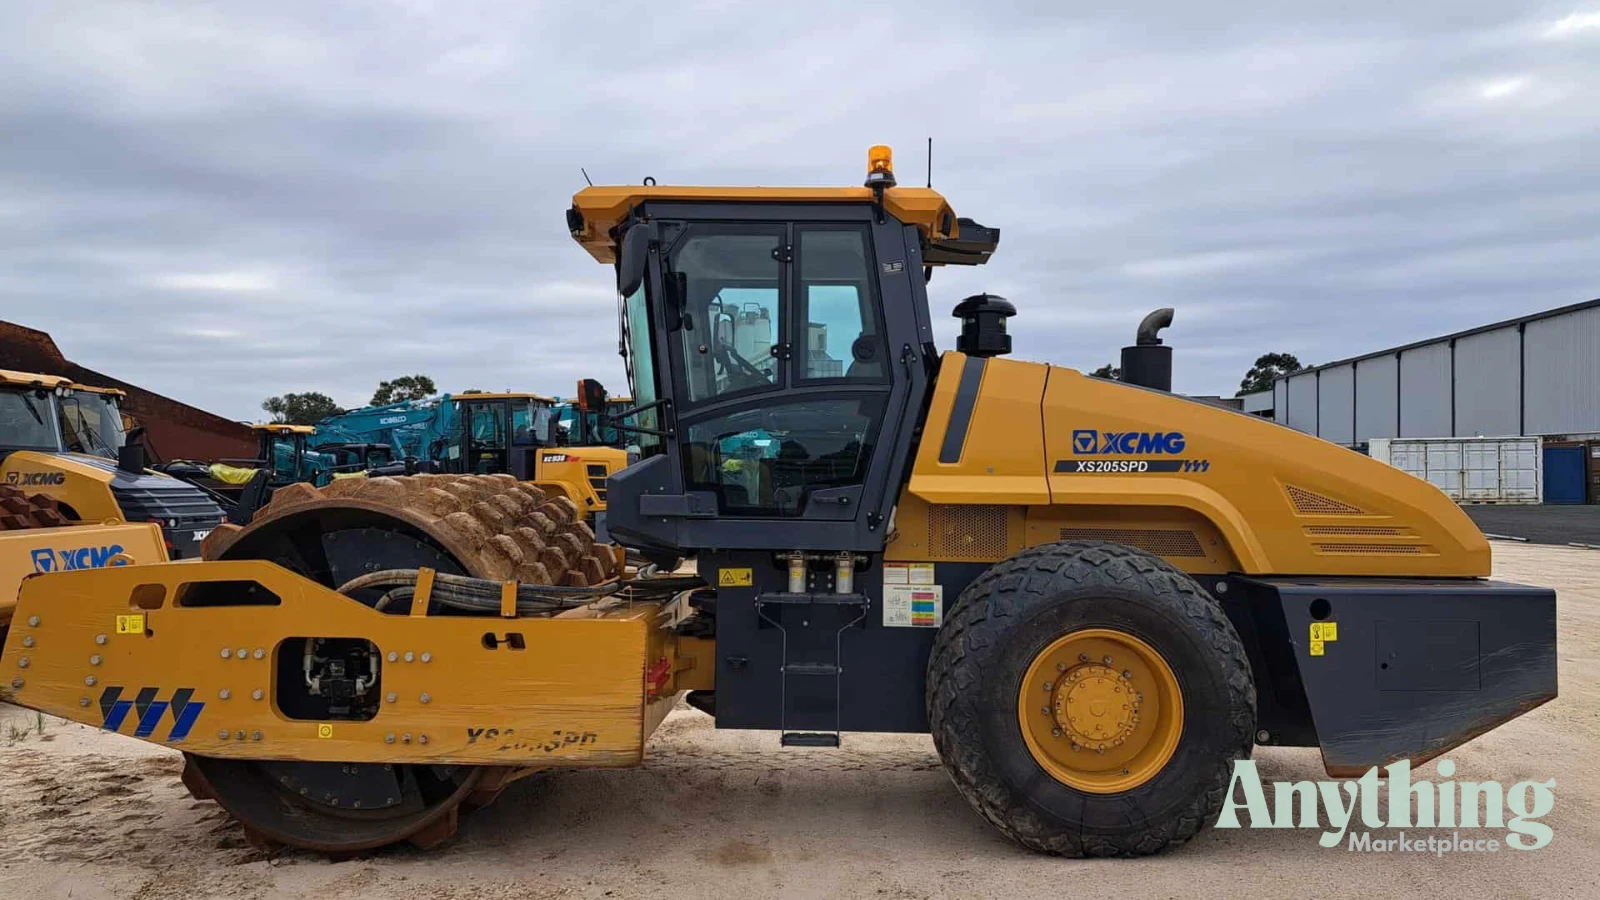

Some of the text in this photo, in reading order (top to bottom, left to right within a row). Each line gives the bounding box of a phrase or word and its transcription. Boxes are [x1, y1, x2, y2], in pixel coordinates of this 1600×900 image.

[1099, 432, 1185, 454] XCMG
[1075, 460, 1148, 472] XS205SPD
[20, 472, 66, 485] XCMG
